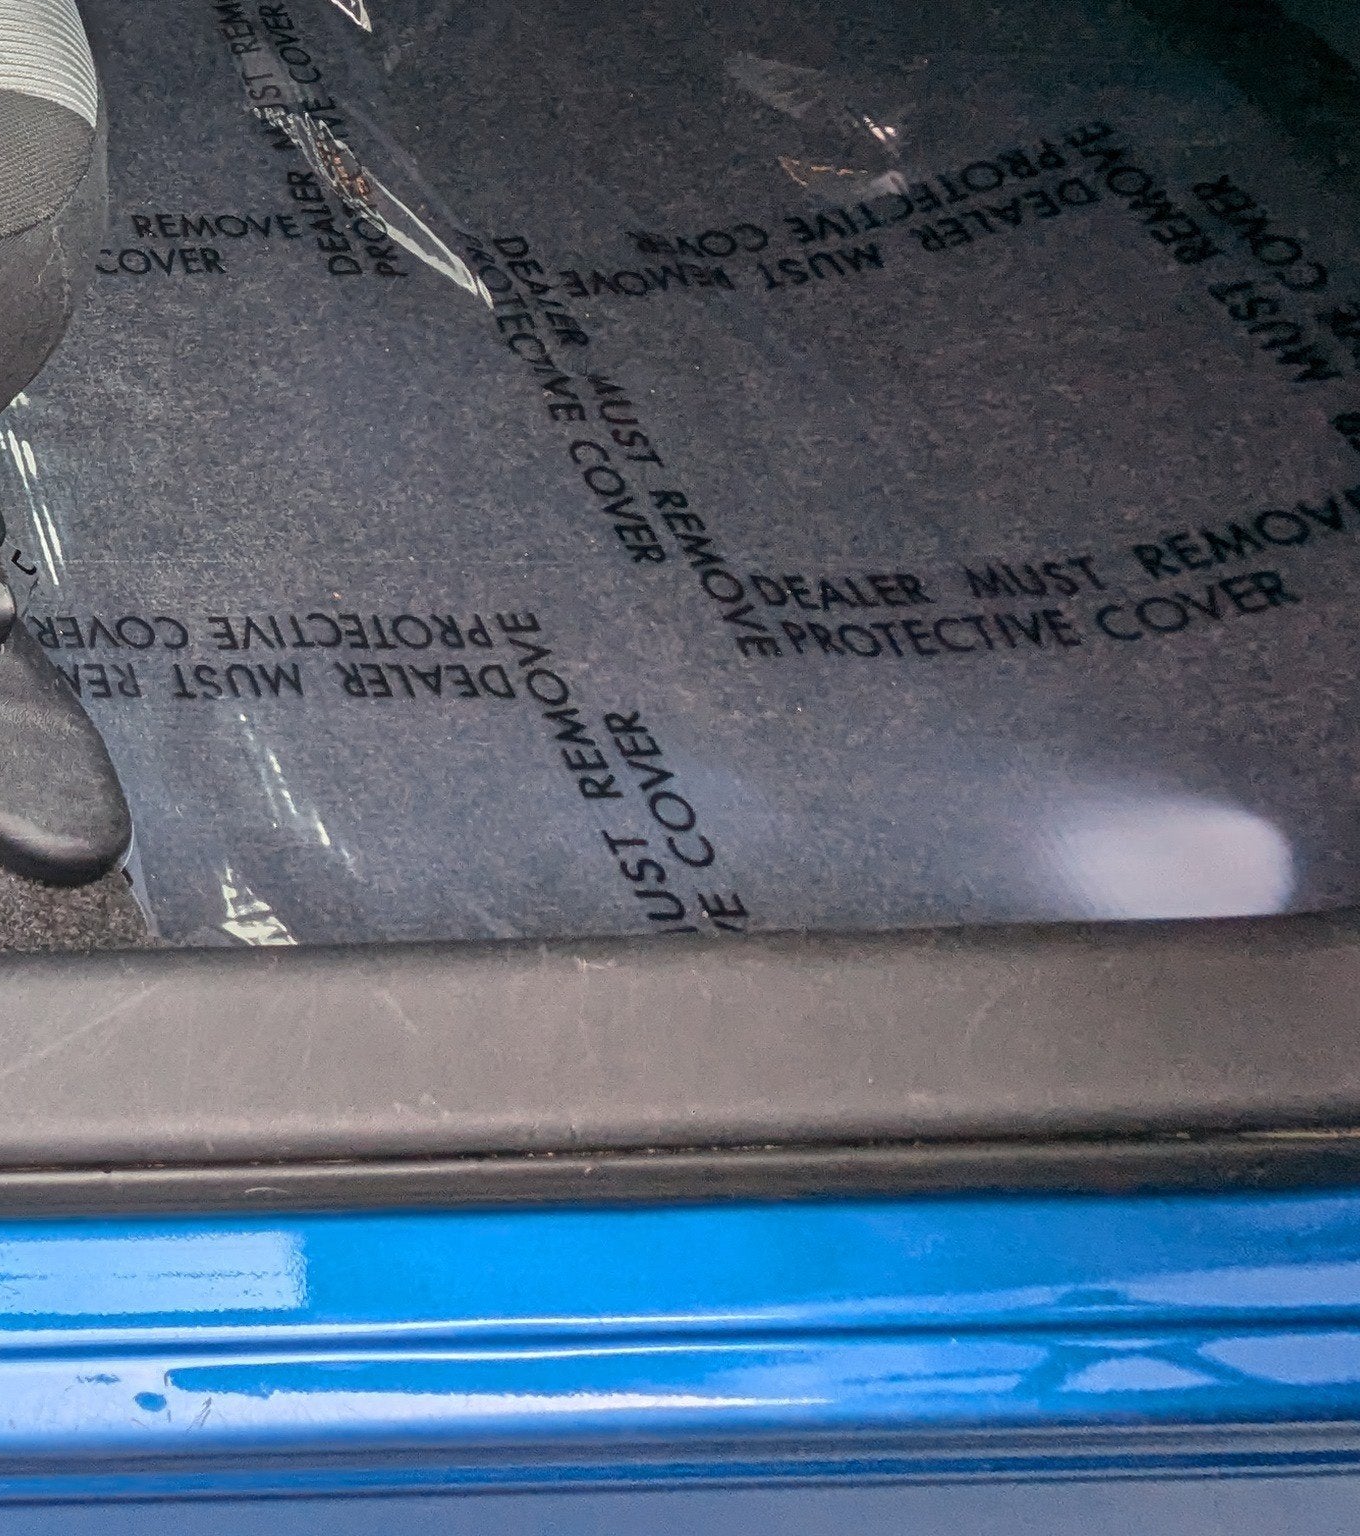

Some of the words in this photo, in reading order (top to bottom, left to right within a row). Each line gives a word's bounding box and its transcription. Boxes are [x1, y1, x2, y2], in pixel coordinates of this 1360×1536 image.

[259, 2, 322, 84] COVER
[131, 214, 301, 239] REMOVE
[784, 140, 1066, 245] PROTECTIVE
[910, 178, 1099, 253] DEALER
[758, 243, 885, 291] MUST
[570, 440, 666, 564] COVER
[586, 373, 665, 468] MUST
[648, 490, 784, 657] REMOVE
[749, 574, 936, 611] DEALER
[962, 555, 1108, 599] MUST
[781, 609, 1082, 658] PROTECTIVE
[1096, 570, 1302, 641] COVER
[29, 615, 188, 650] COVER
[209, 612, 494, 650] PROTECTIVE
[173, 663, 305, 700] MUST
[337, 663, 516, 700] DEALER
[496, 612, 624, 799] REMOVE
[603, 710, 716, 868] COVER
